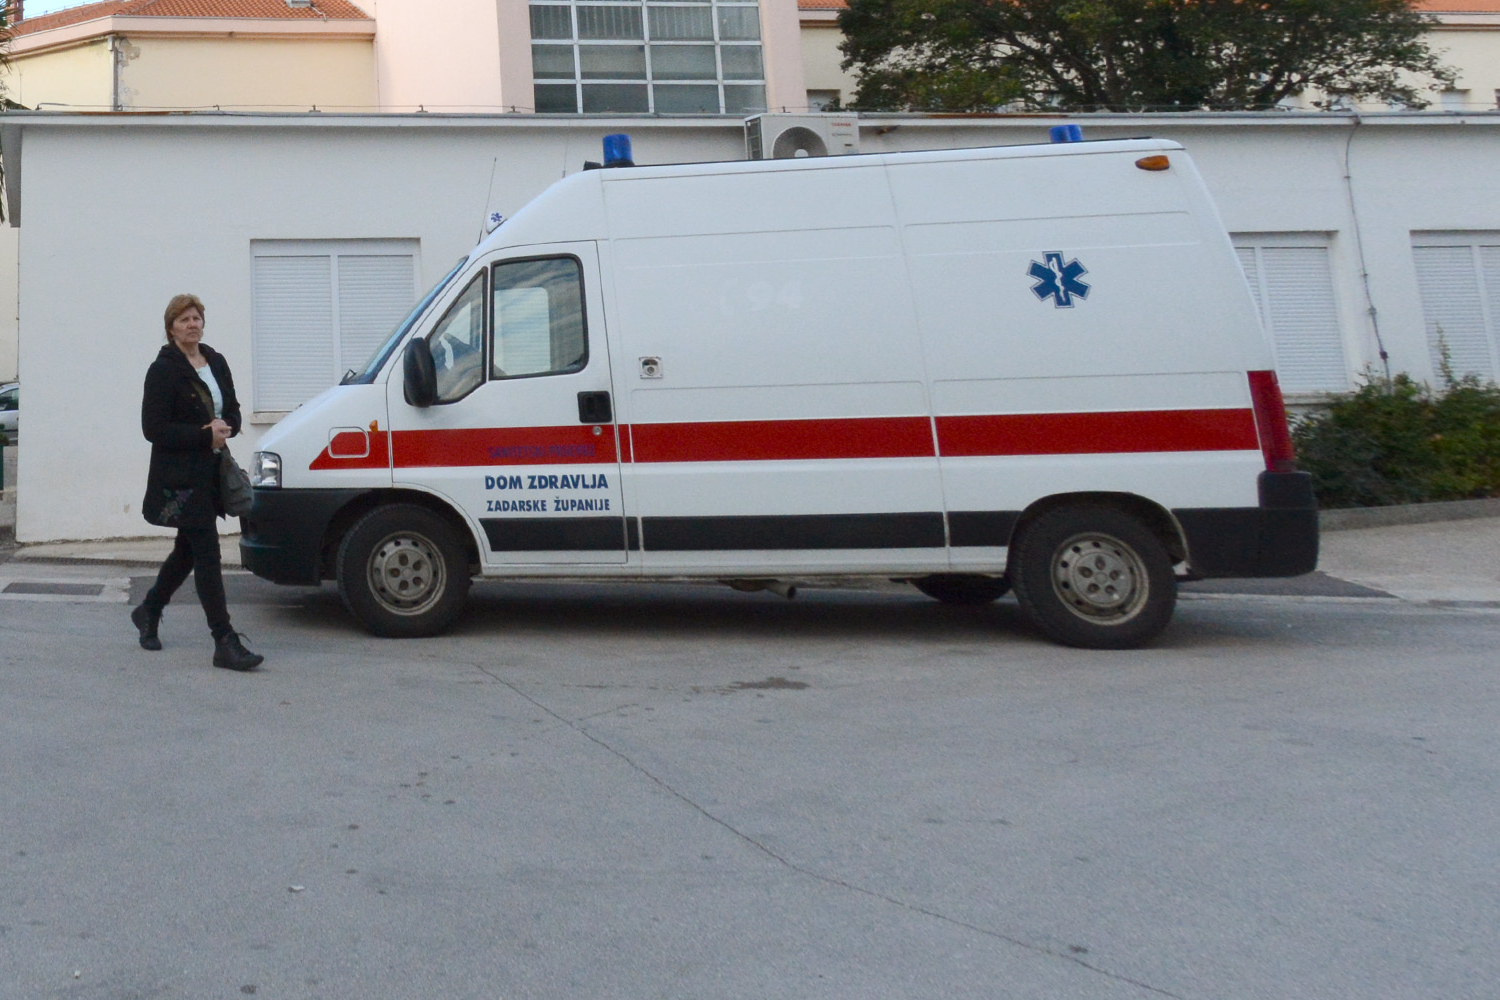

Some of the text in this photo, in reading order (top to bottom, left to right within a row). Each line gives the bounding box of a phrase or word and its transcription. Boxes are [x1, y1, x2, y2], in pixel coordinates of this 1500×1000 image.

[485, 474, 608, 490] DOM ZDRAVLJA
[486, 496, 610, 512] ZADARSKE ŽUPANIJE
